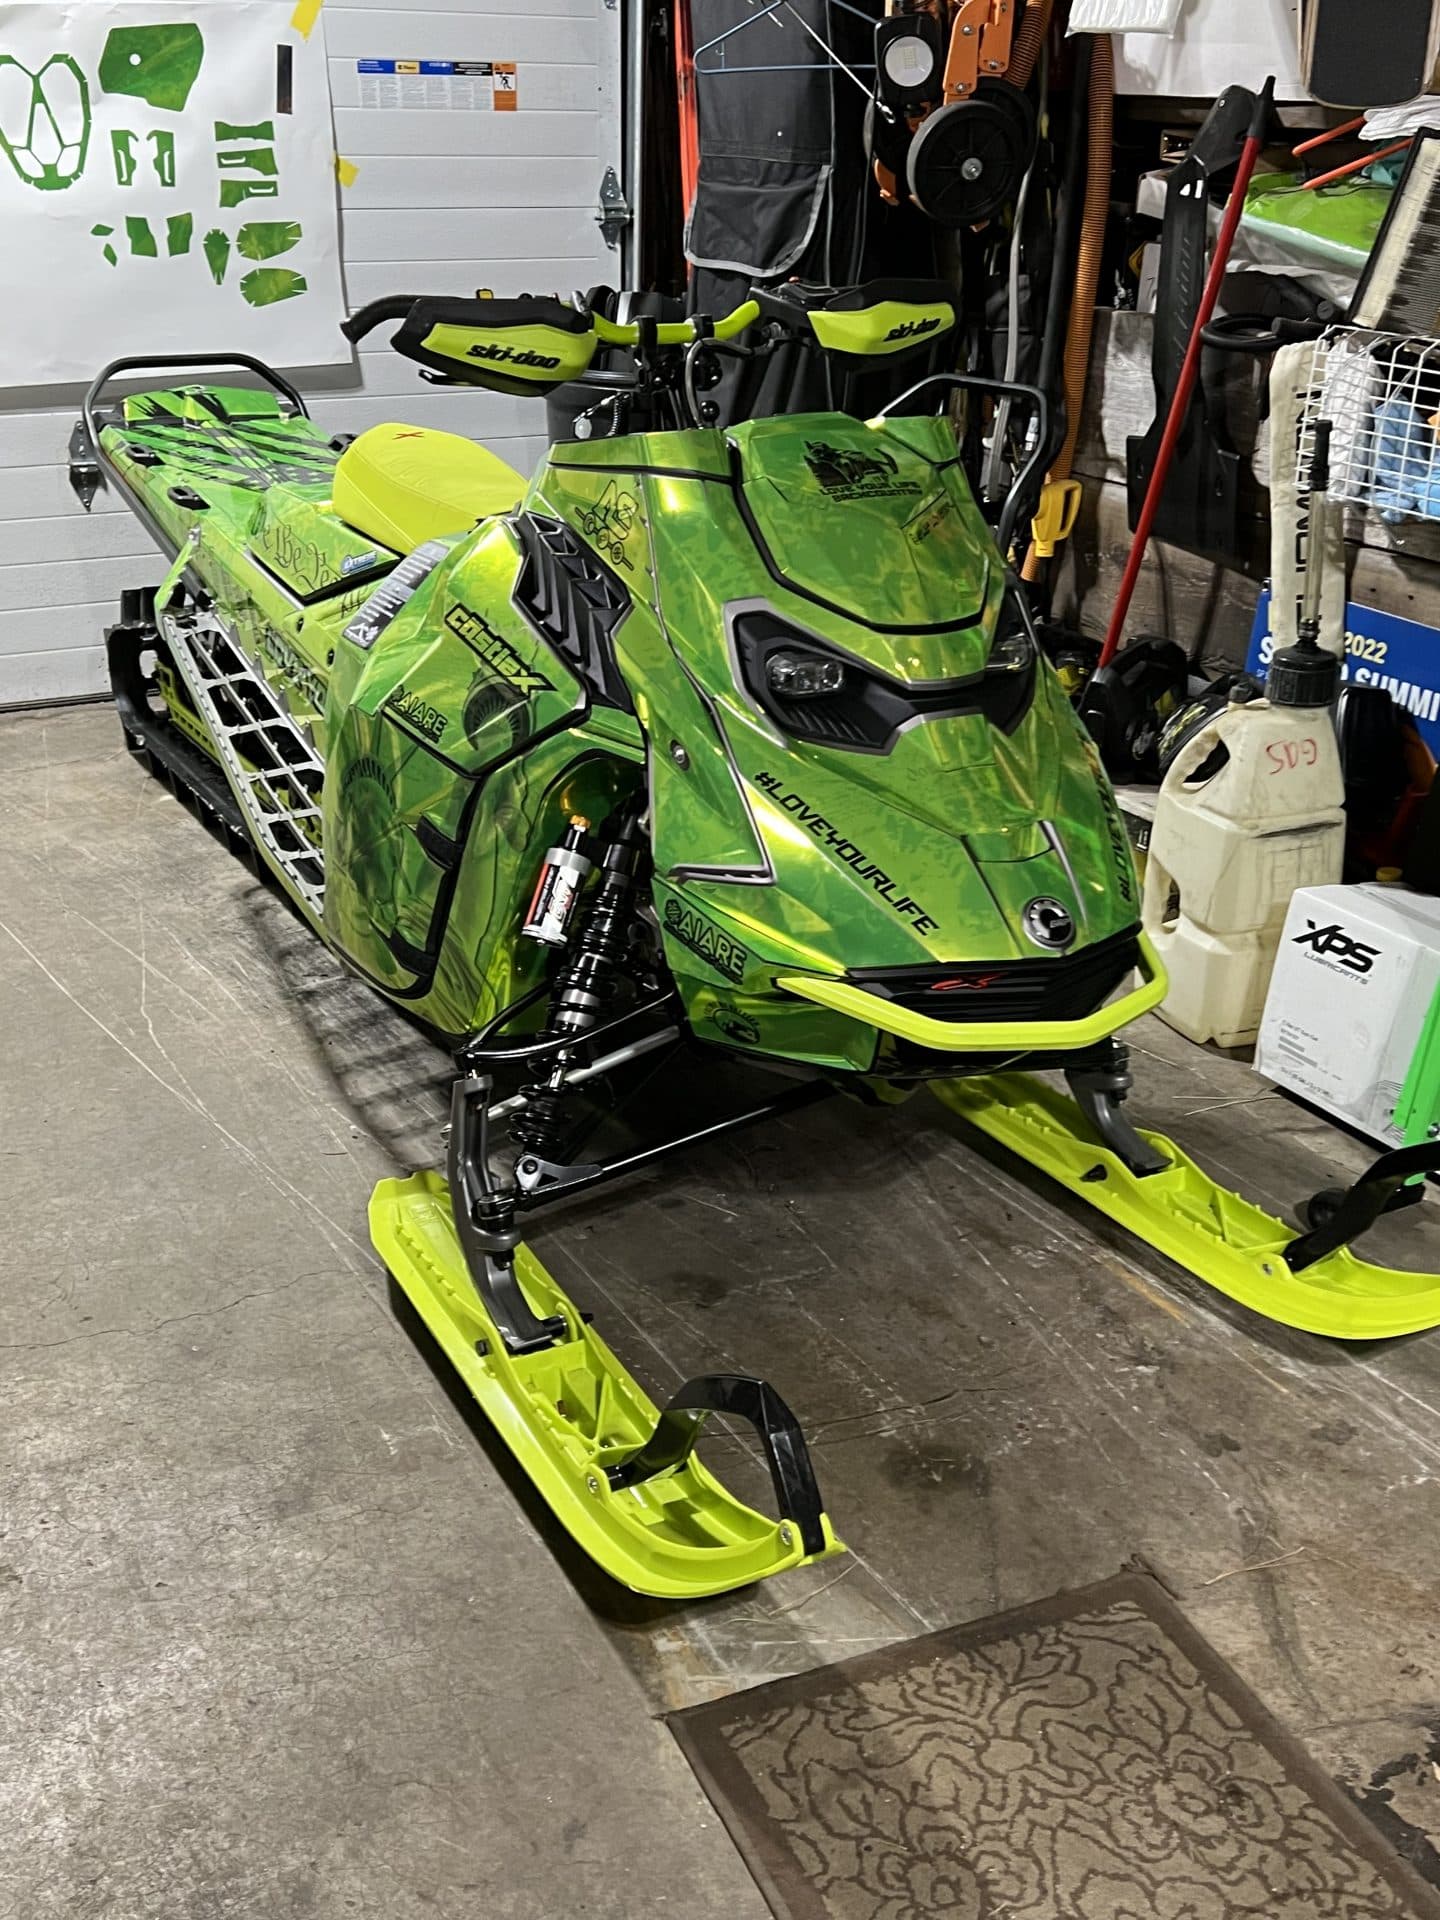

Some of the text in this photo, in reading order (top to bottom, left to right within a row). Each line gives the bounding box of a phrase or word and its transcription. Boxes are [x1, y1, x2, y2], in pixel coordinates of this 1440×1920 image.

[466, 344, 561, 369] ski-doo
[855, 481, 891, 491] YOUR
[1344, 631, 1388, 665] 2022
[396, 691, 448, 739] AIARE
[755, 772, 939, 936] #LOVEYOURLIFE
[677, 910, 747, 977] AIARE
[1291, 918, 1383, 973] XPS
[1304, 951, 1369, 985] LUBRICANTS
